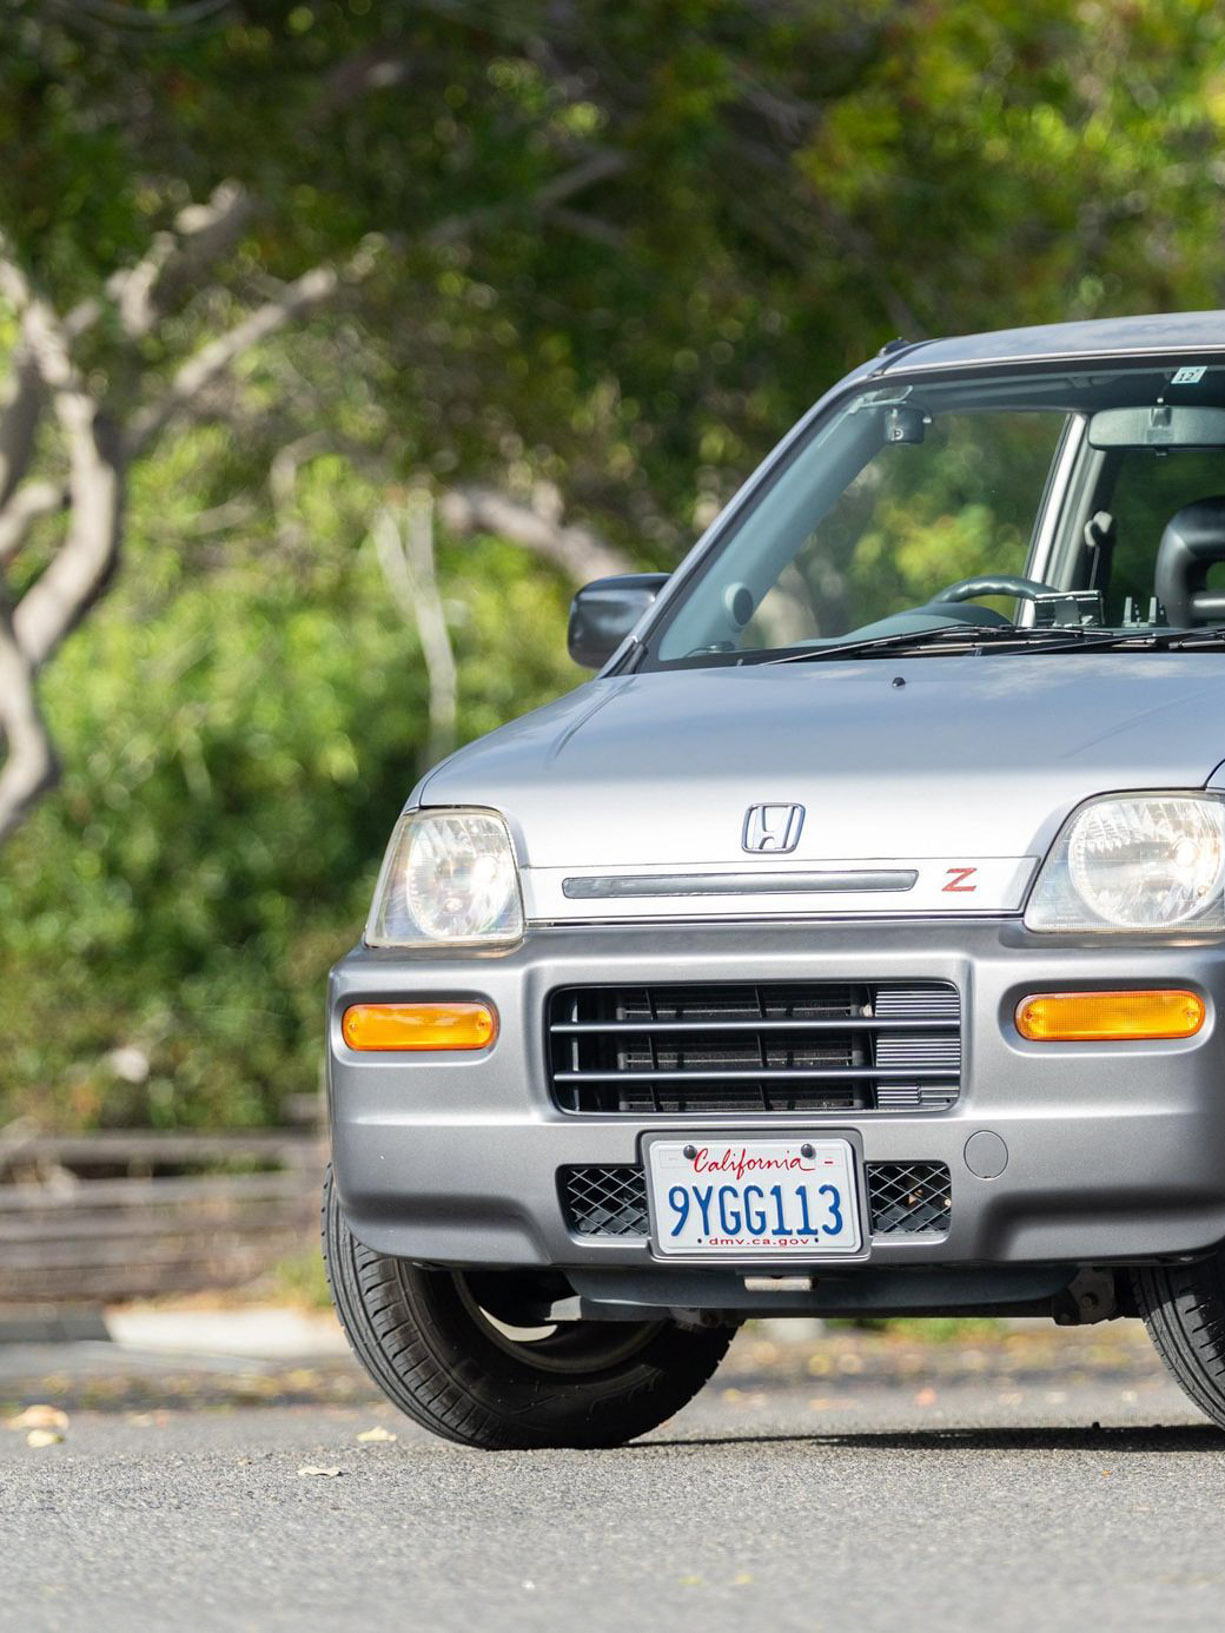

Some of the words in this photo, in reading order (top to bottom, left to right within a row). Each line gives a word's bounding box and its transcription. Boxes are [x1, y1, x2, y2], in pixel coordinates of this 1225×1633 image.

[941, 867, 977, 892] Z
[693, 1148, 815, 1181] California
[668, 1184, 844, 1237] 9YGG113
[708, 1236, 810, 1247] dmv.ca.gov
